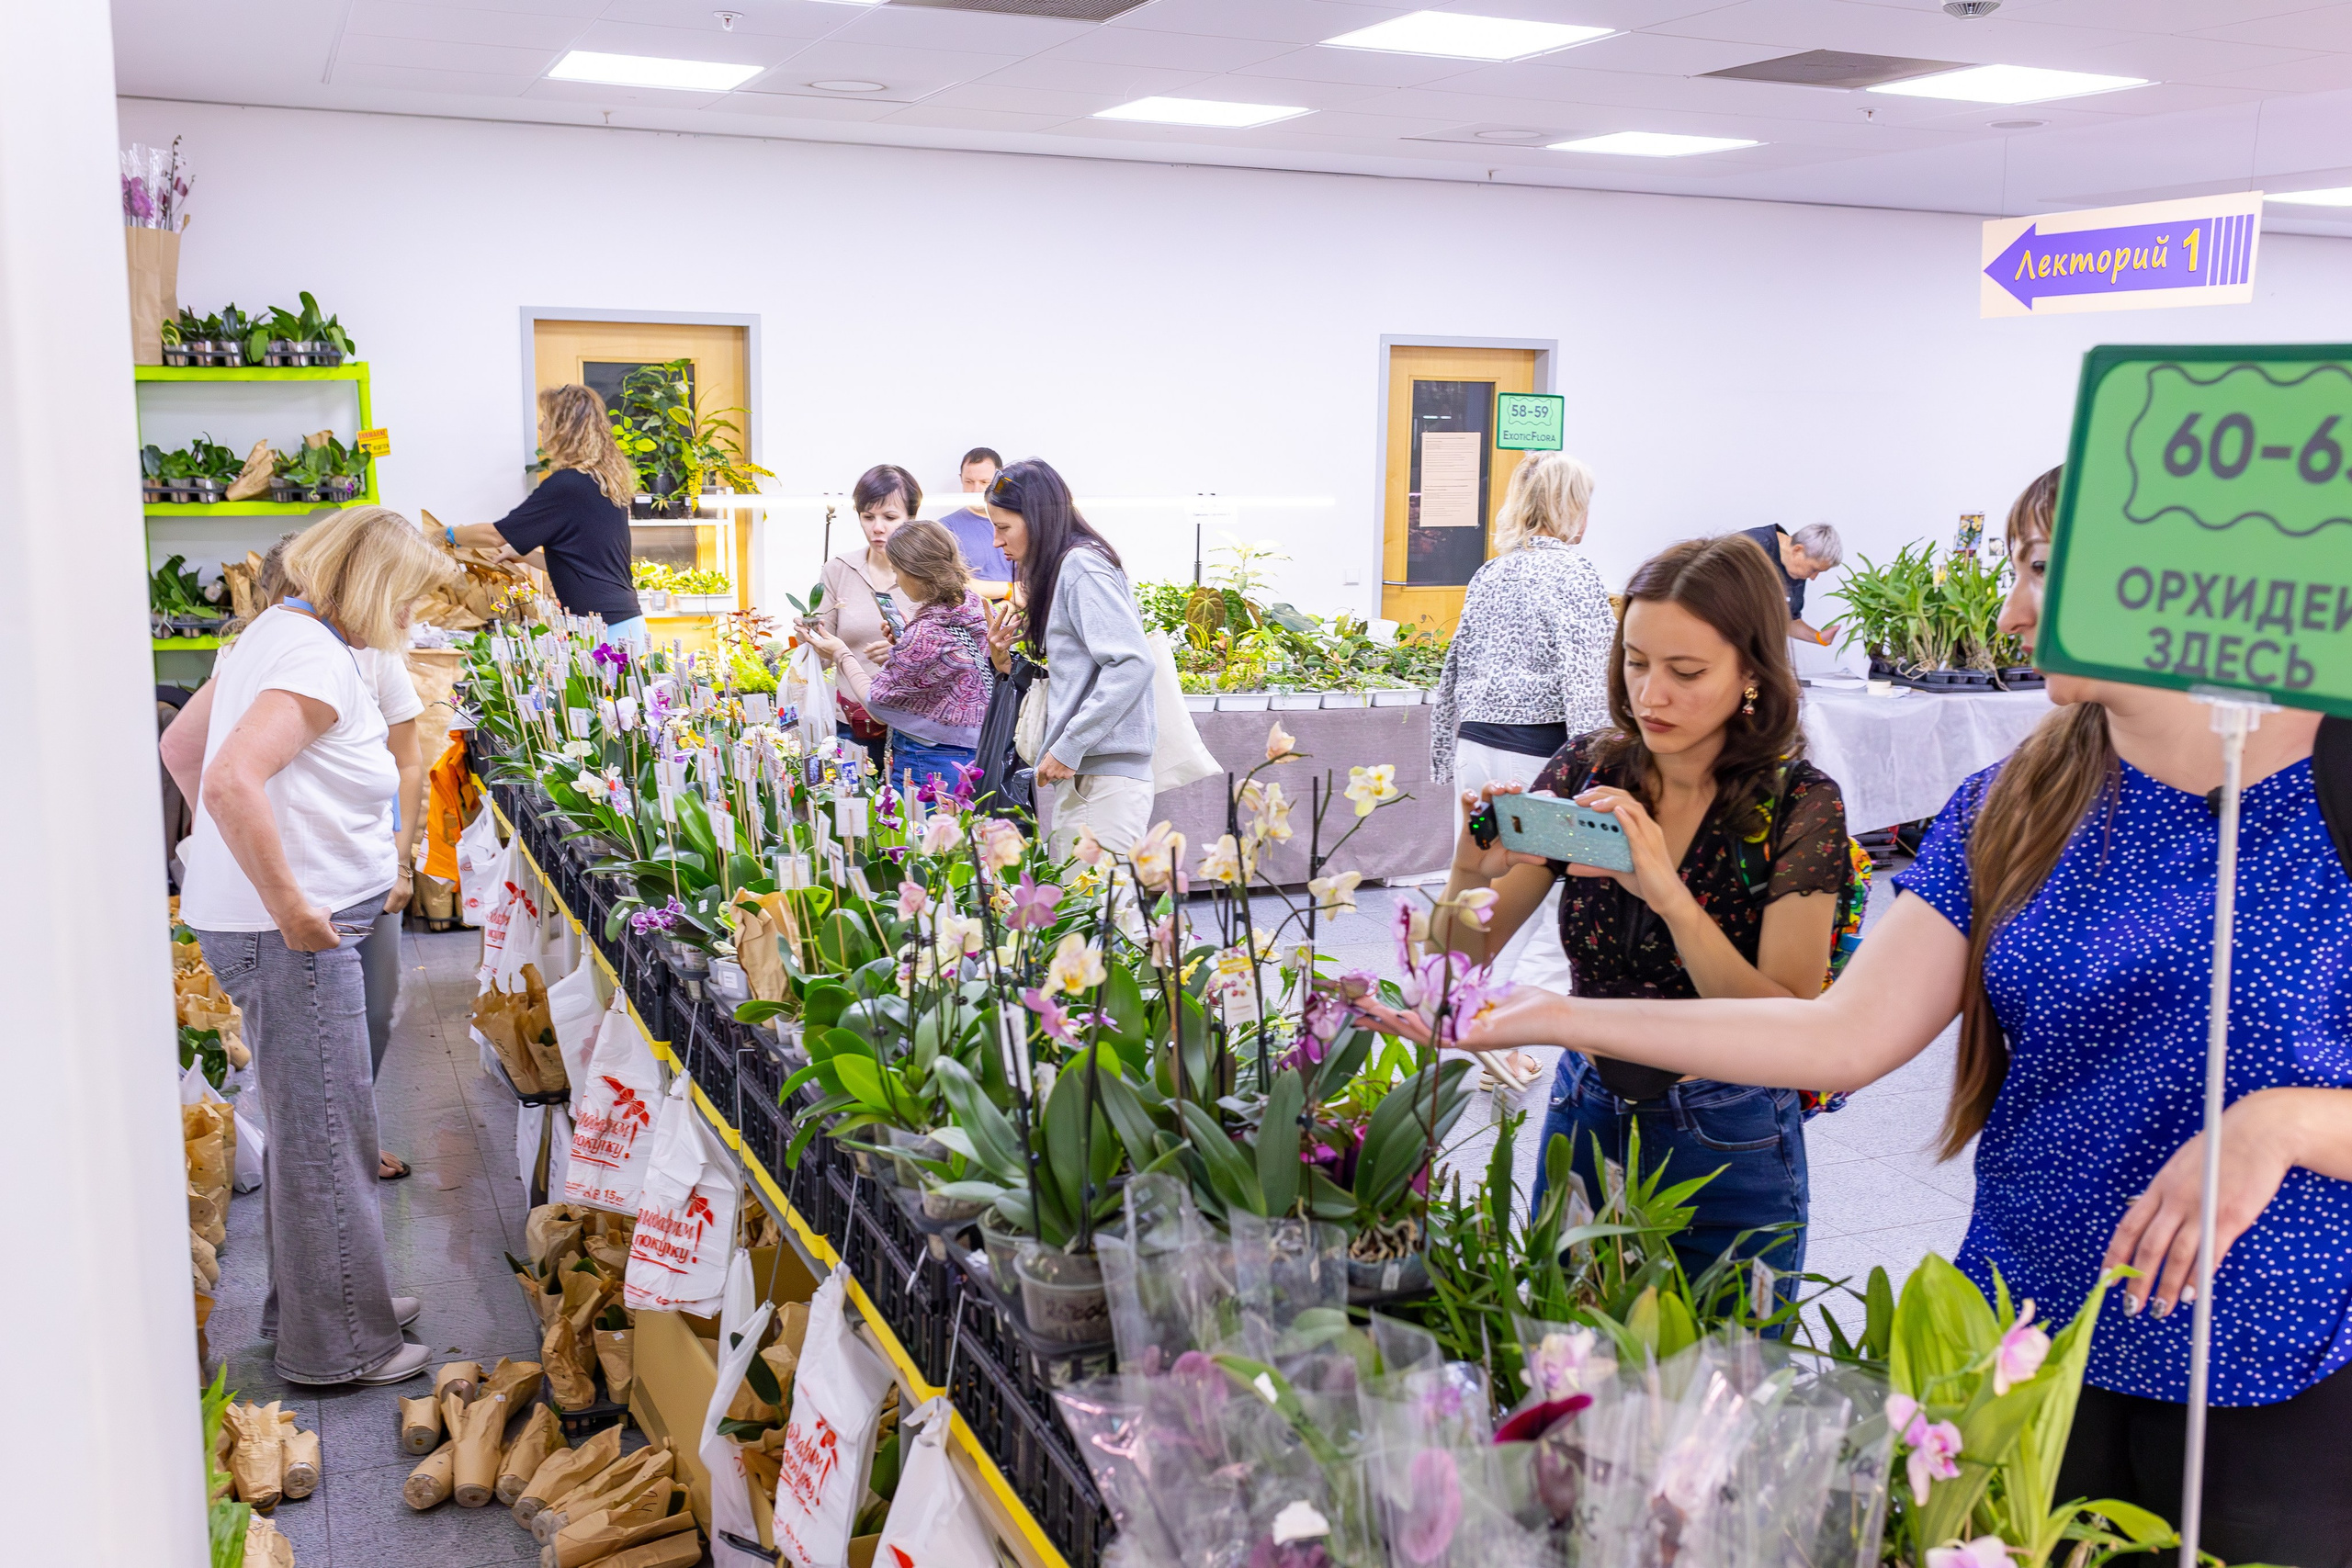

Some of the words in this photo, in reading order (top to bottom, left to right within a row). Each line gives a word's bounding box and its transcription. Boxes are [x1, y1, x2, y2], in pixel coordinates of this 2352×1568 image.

[2014, 234, 2170, 285] Лекторий
[2182, 228, 2200, 272] 1
[1511, 404, 1549, 418] 58-59
[2163, 412, 2352, 485] 60-6
[2143, 626, 2316, 690] ЗДЕСЬ
